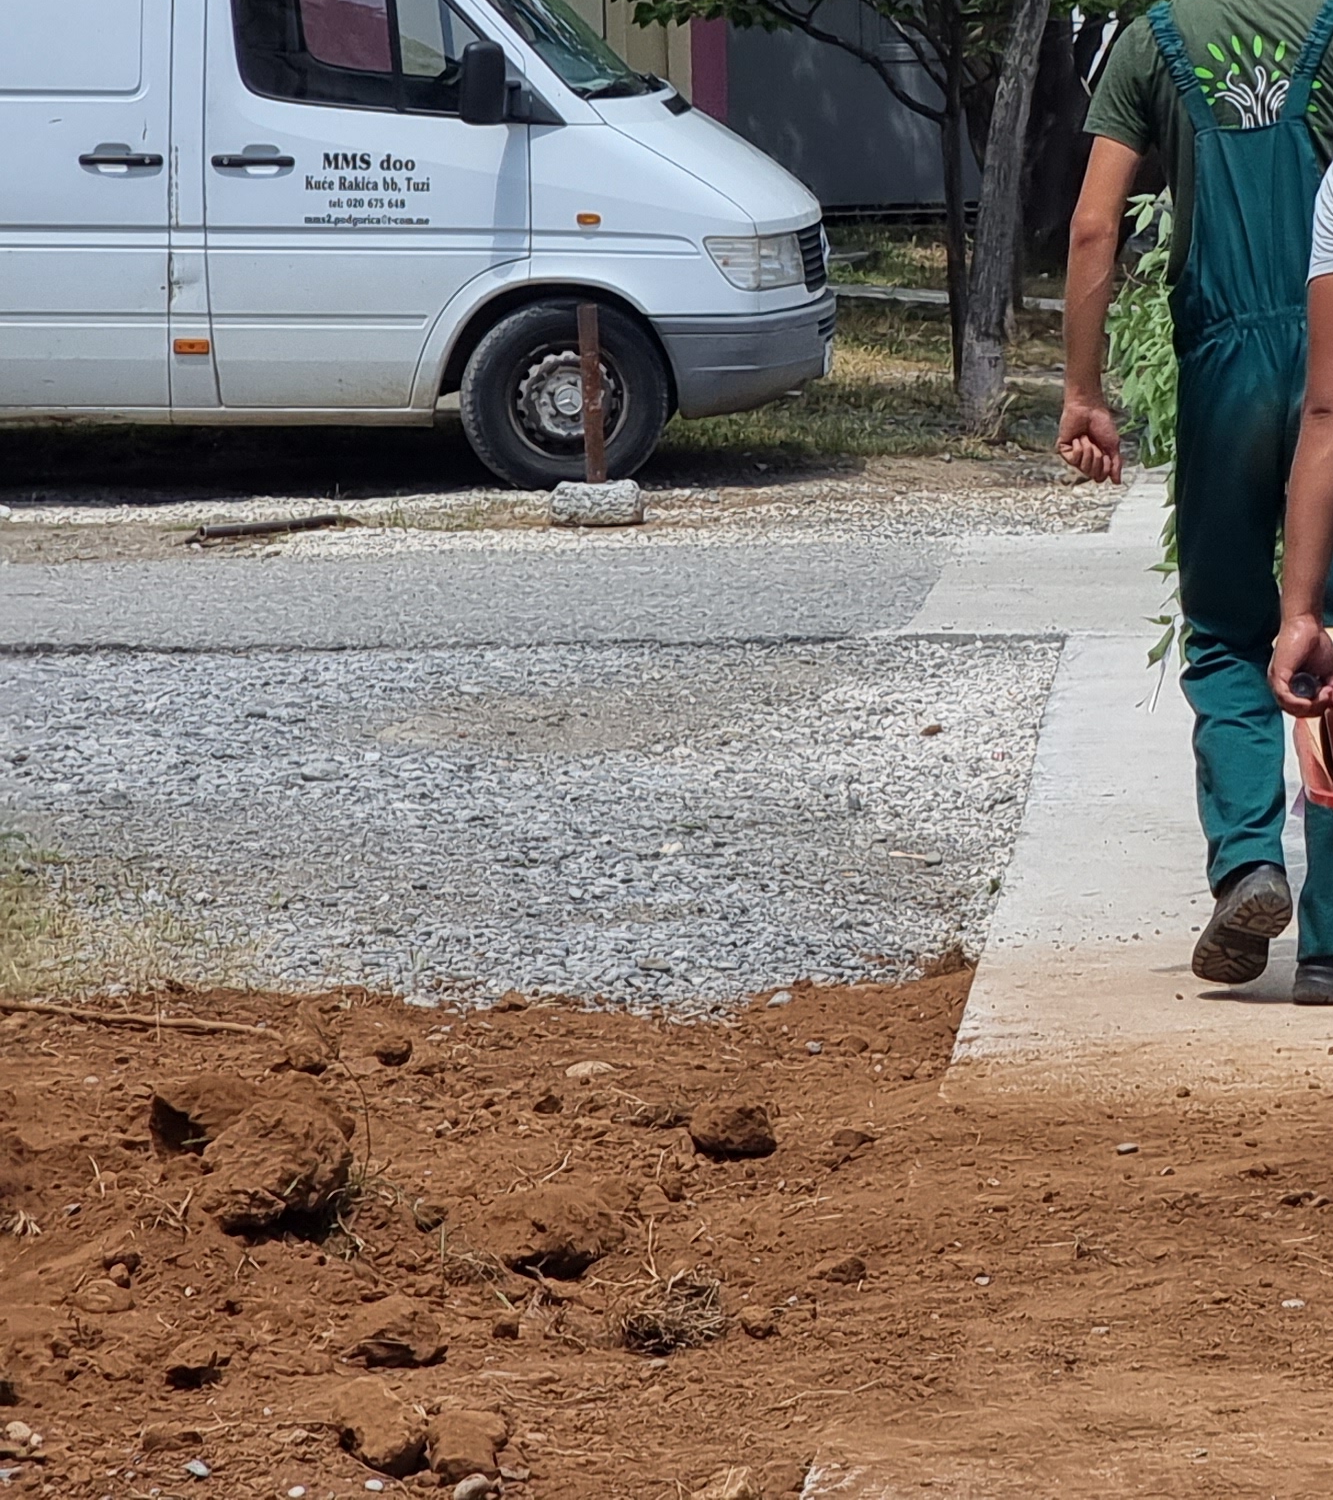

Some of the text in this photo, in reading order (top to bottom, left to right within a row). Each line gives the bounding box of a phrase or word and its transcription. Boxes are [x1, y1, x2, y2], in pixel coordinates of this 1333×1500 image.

[322, 152, 416, 171] MMS doo
[305, 175, 430, 193] Kuće Rakića bb, Tuzi
[346, 198, 364, 209] 020
[367, 198, 384, 209] 675
